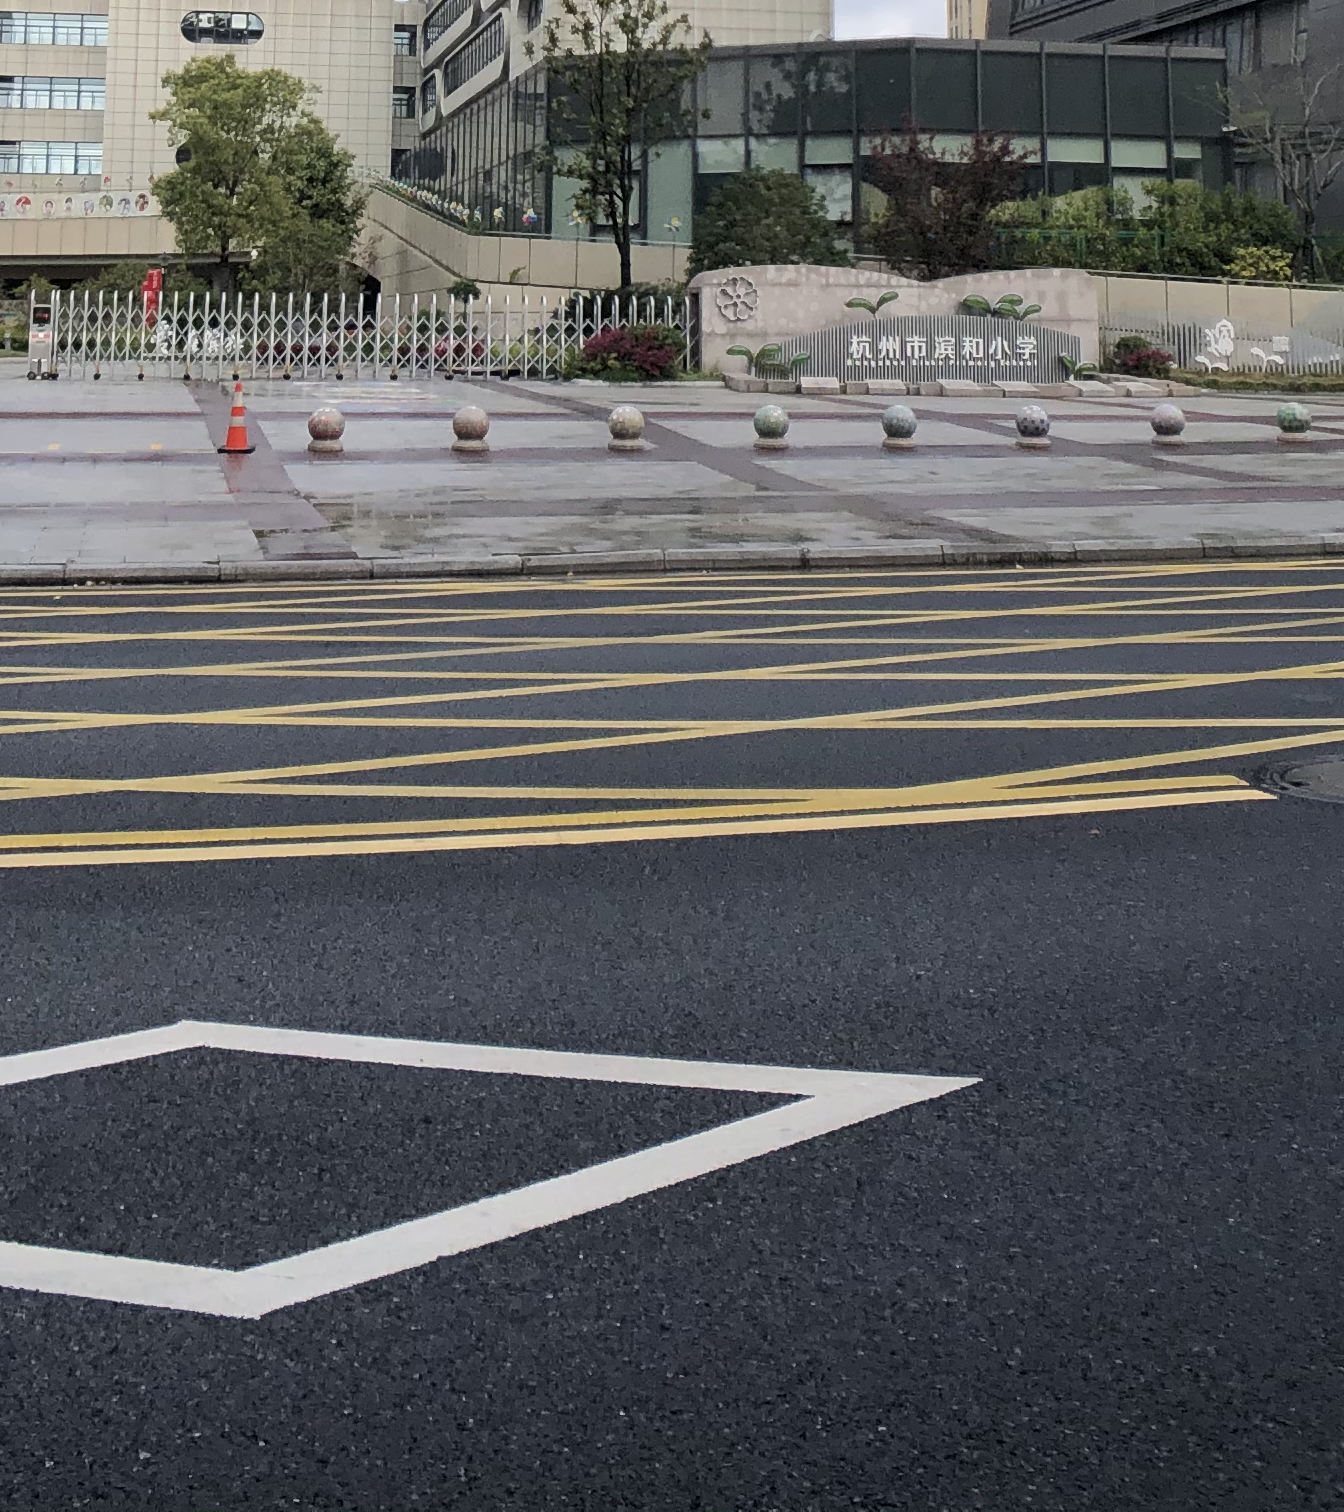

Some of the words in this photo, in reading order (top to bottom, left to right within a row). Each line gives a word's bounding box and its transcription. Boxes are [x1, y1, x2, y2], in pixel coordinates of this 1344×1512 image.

[849, 335, 1037, 360] 杭州市滨和小学
